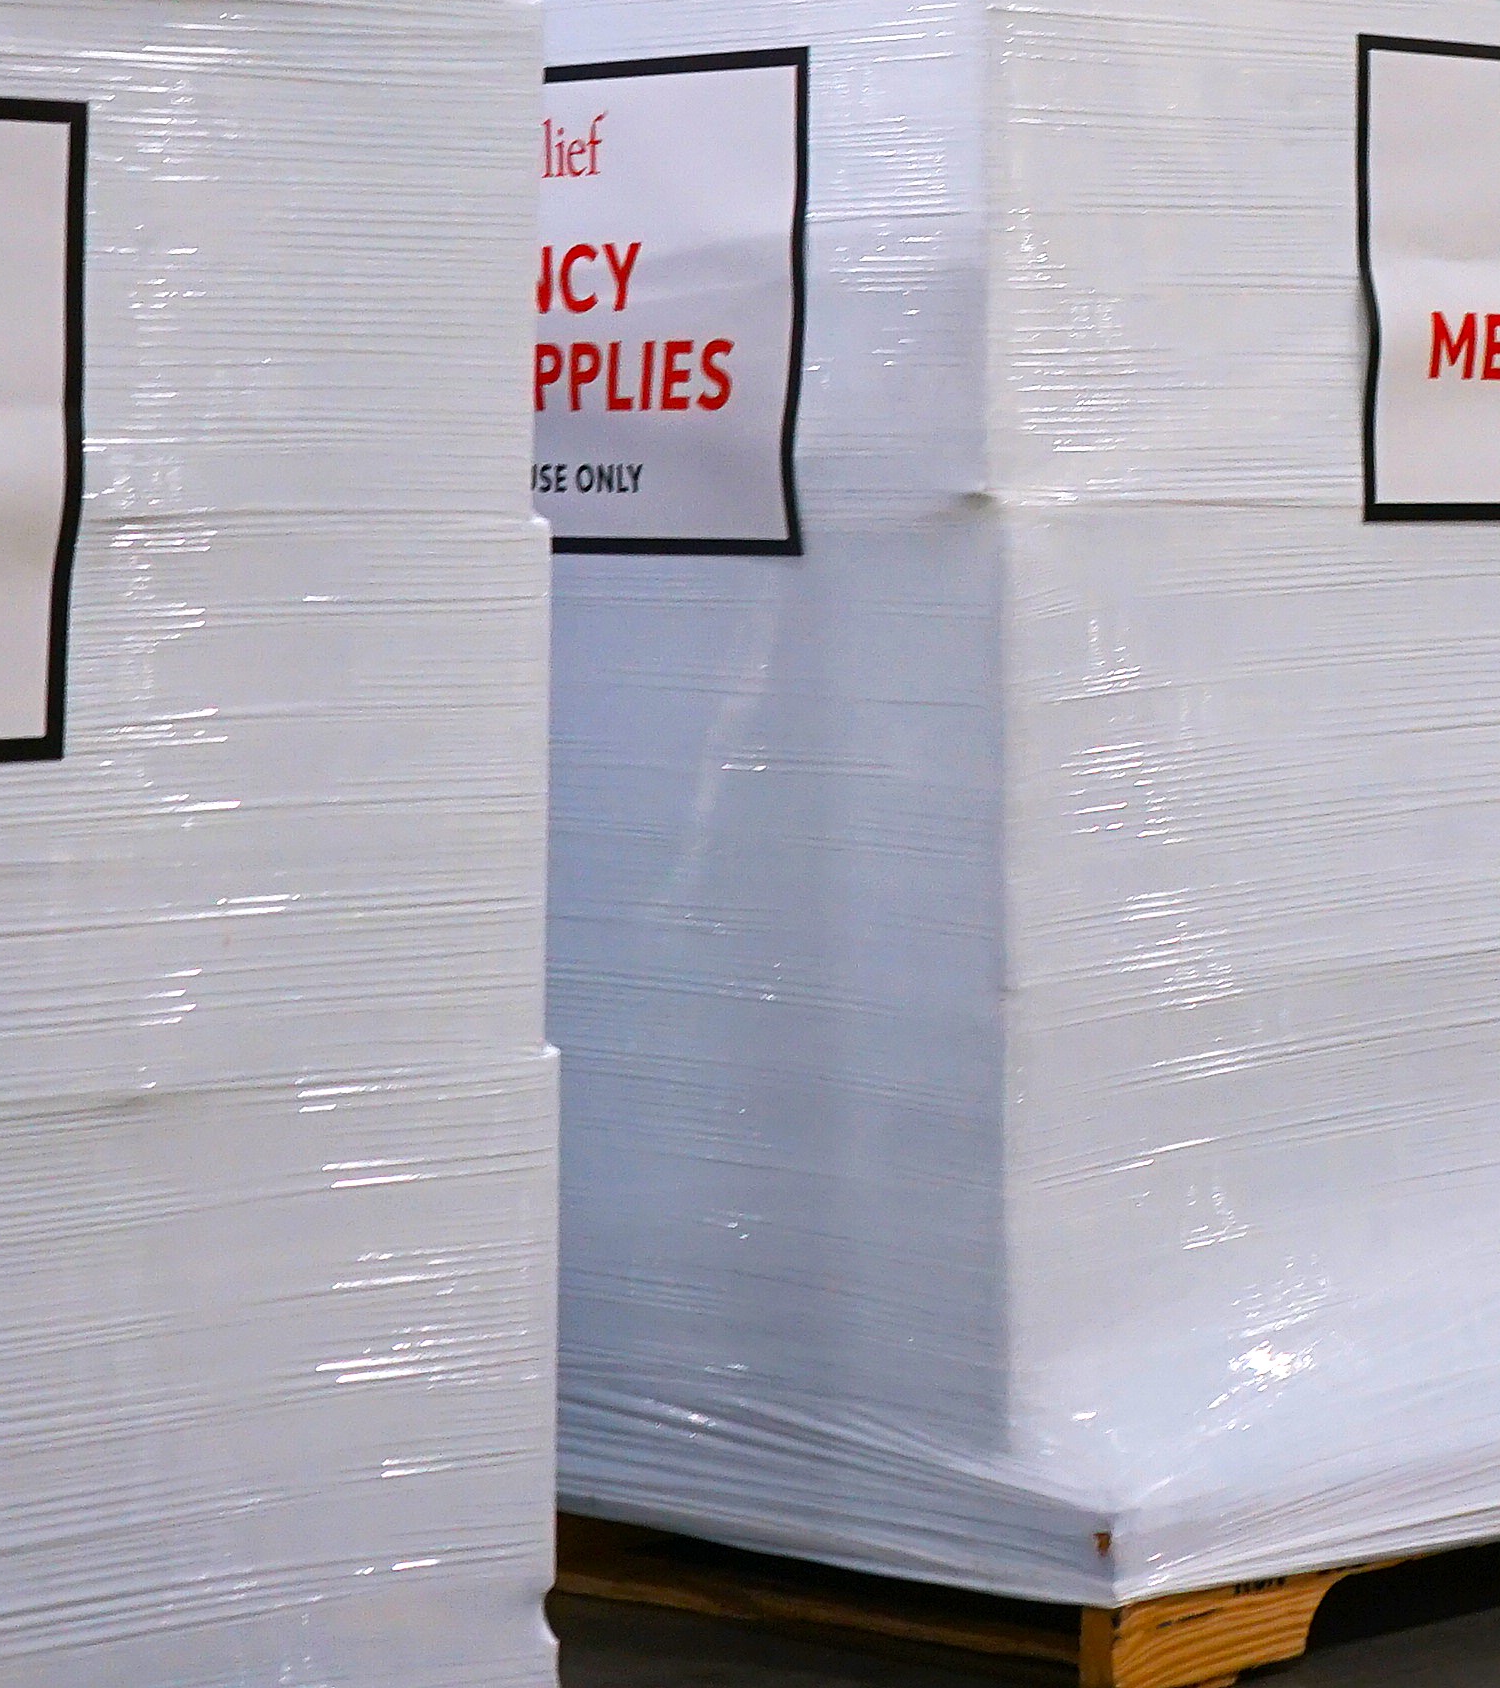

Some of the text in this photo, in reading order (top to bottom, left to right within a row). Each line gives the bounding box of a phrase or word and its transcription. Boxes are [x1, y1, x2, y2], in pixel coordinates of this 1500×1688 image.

[541, 113, 606, 179] lief
[532, 338, 734, 412] PPLIES
[575, 463, 644, 494] ONLY
